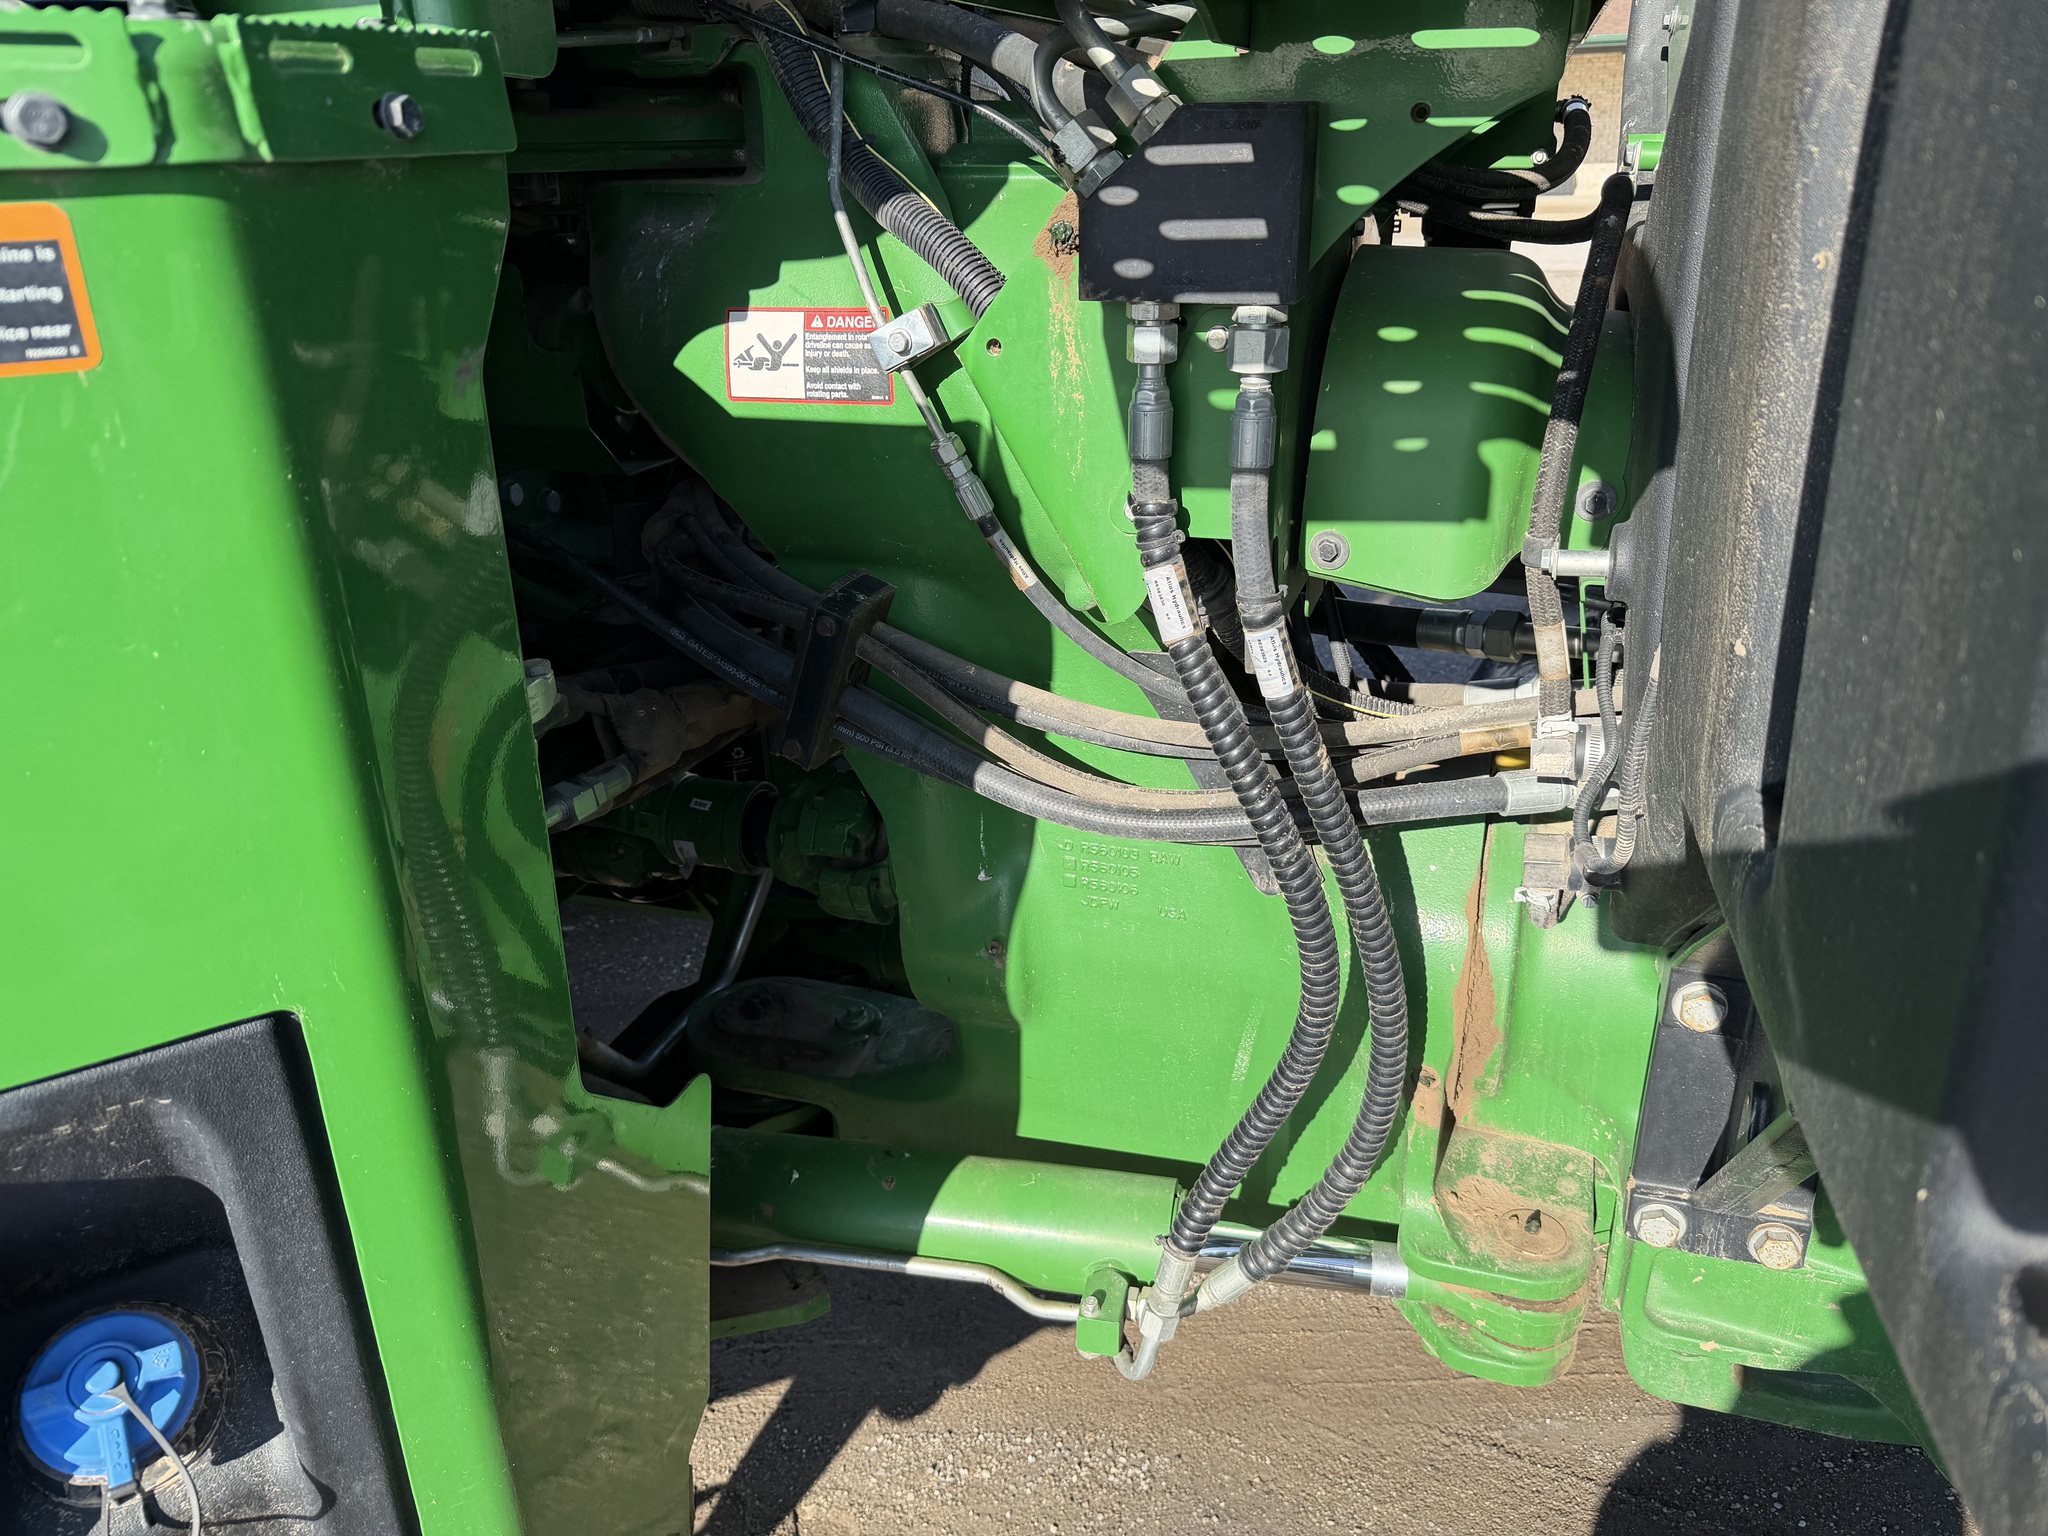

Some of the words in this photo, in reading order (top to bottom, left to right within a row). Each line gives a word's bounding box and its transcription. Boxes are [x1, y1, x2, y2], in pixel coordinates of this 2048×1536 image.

[0, 246, 33, 264] ine
[35, 245, 56, 262] is
[826, 315, 876, 328] DANGE
[30, 323, 72, 340] near
[805, 332, 847, 342] Entanglement
[848, 333, 854, 341] in
[805, 341, 831, 349] driveline
[805, 349, 822, 358] injury
[832, 350, 850, 358] death.
[805, 365, 821, 375] Keep
[830, 366, 853, 374] shields
[854, 366, 860, 374] in
[861, 366, 880, 375] place.
[806, 381, 823, 390] Avoid
[824, 382, 848, 390] contact
[806, 390, 830, 399] rotating
[831, 391, 849, 399] parts.
[1171, 594, 1187, 630] Hydraulics
[1274, 652, 1287, 686] Hydraulics
[855, 732, 870, 744] 500
[870, 738, 885, 750] PSI
[1148, 850, 1183, 866] RAW
[1157, 905, 1188, 921] USA
